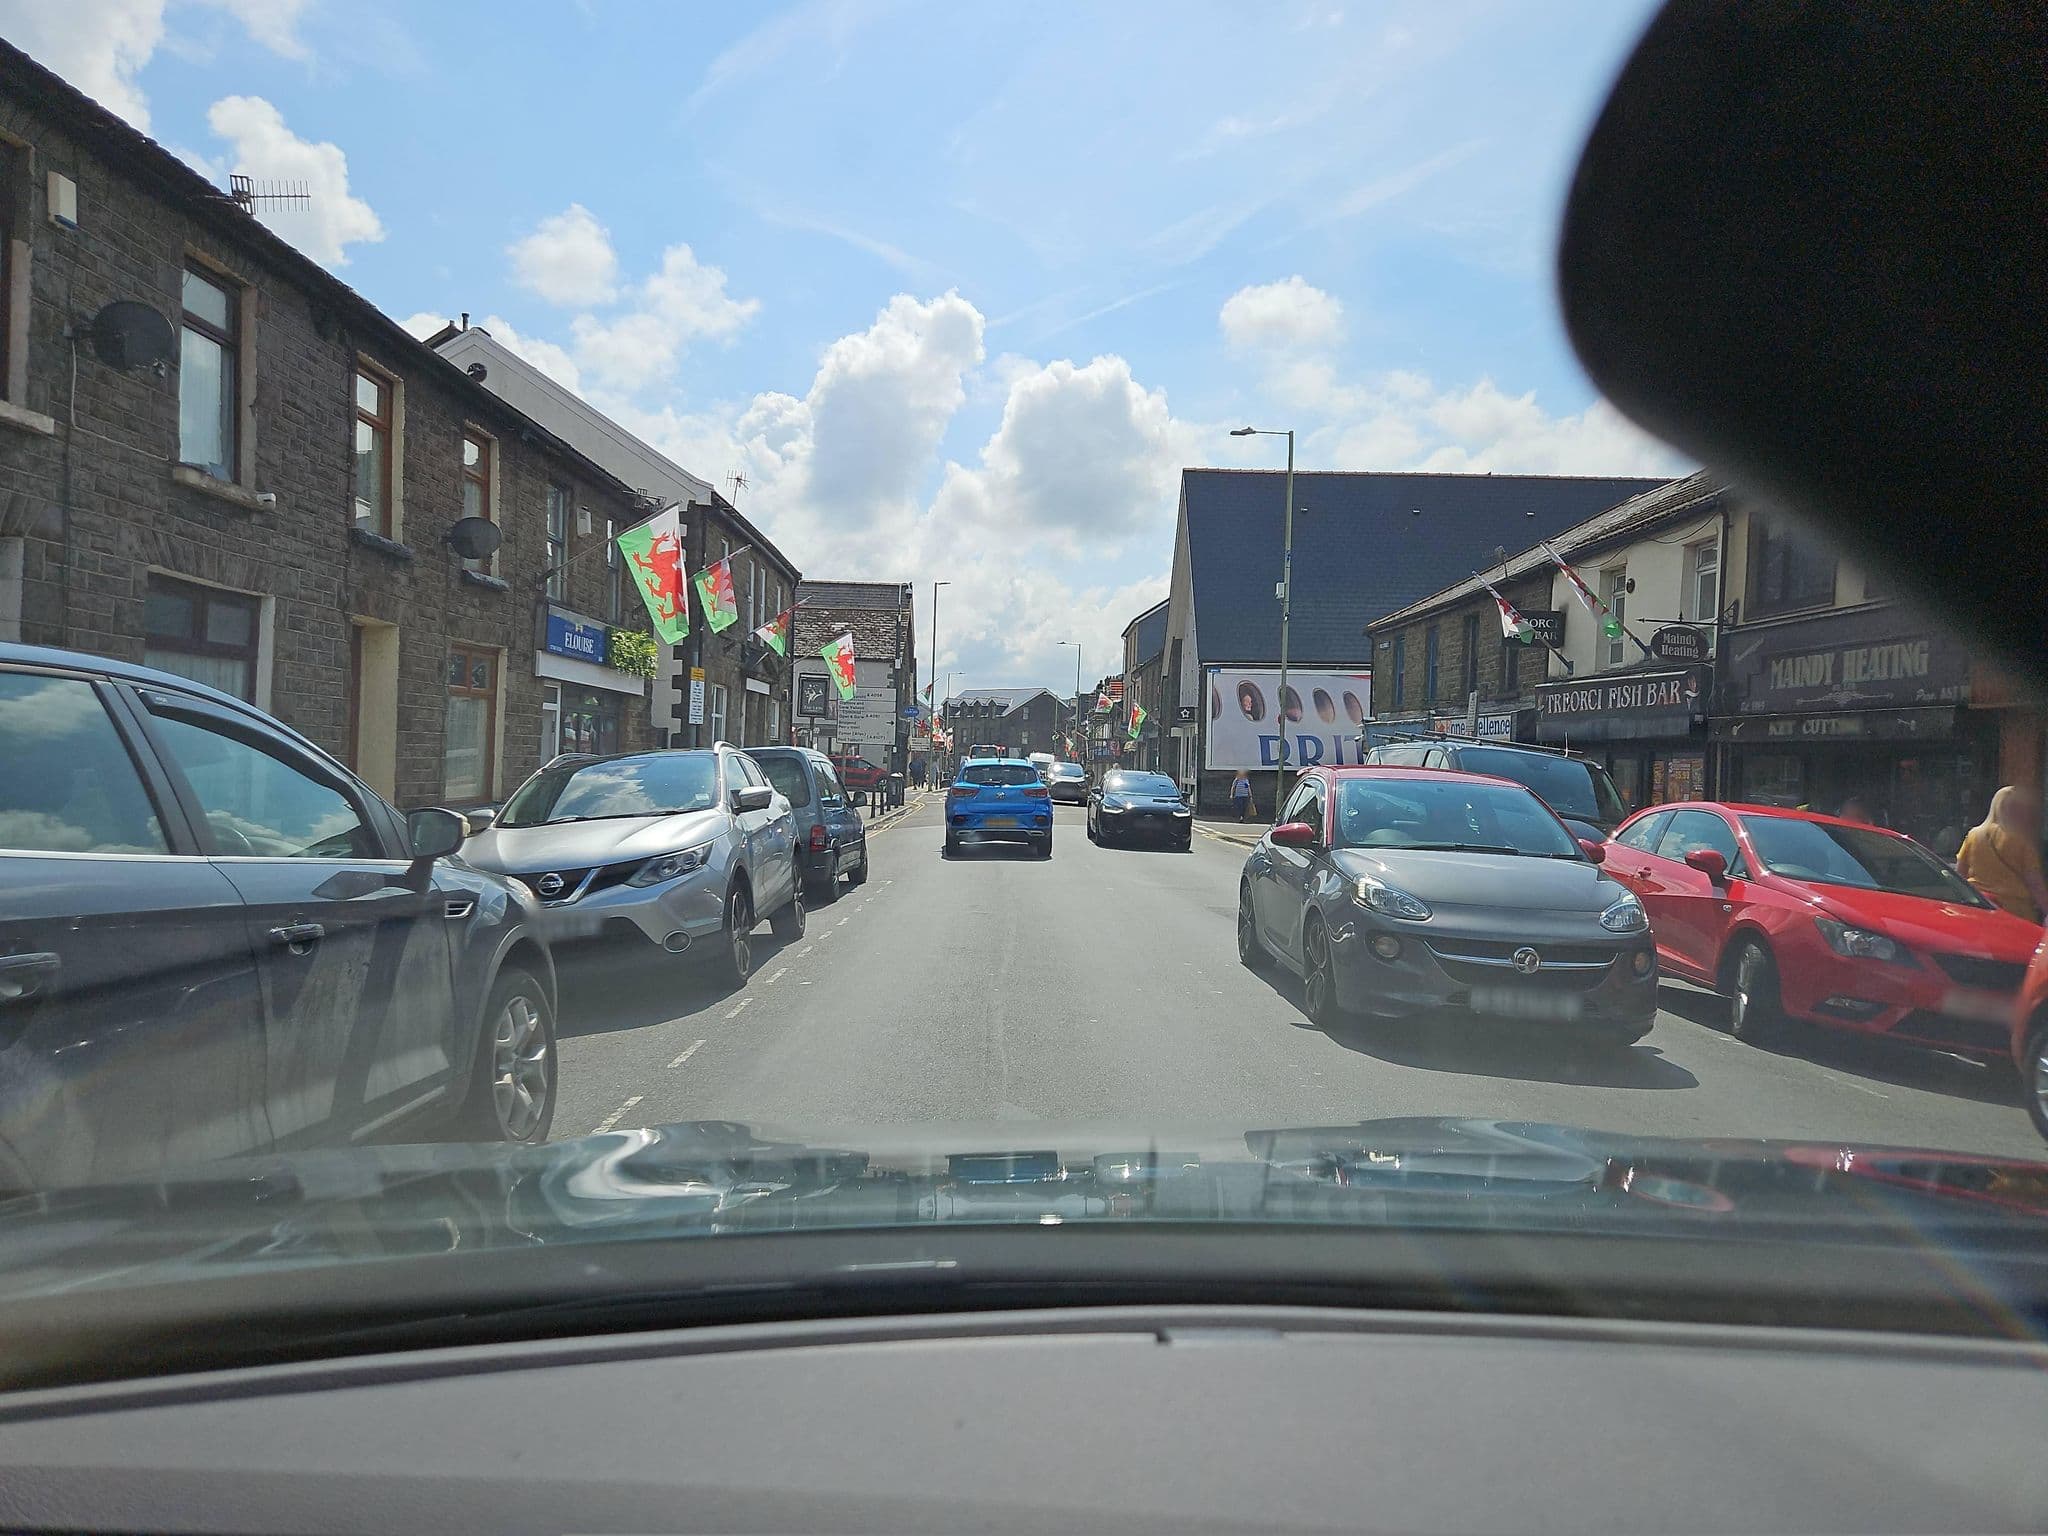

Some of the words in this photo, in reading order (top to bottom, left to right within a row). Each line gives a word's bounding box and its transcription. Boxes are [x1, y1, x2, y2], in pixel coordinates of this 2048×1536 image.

[564, 631, 594, 654] ELOUISE
[1663, 632, 1696, 647] Maindy
[1661, 644, 1699, 659] Heating
[1770, 652, 1835, 690] MAINDY
[1843, 641, 1929, 683] HEATING
[1547, 688, 1603, 714] TREORCI
[1607, 684, 1643, 710] FISH
[1646, 680, 1681, 706] BAR
